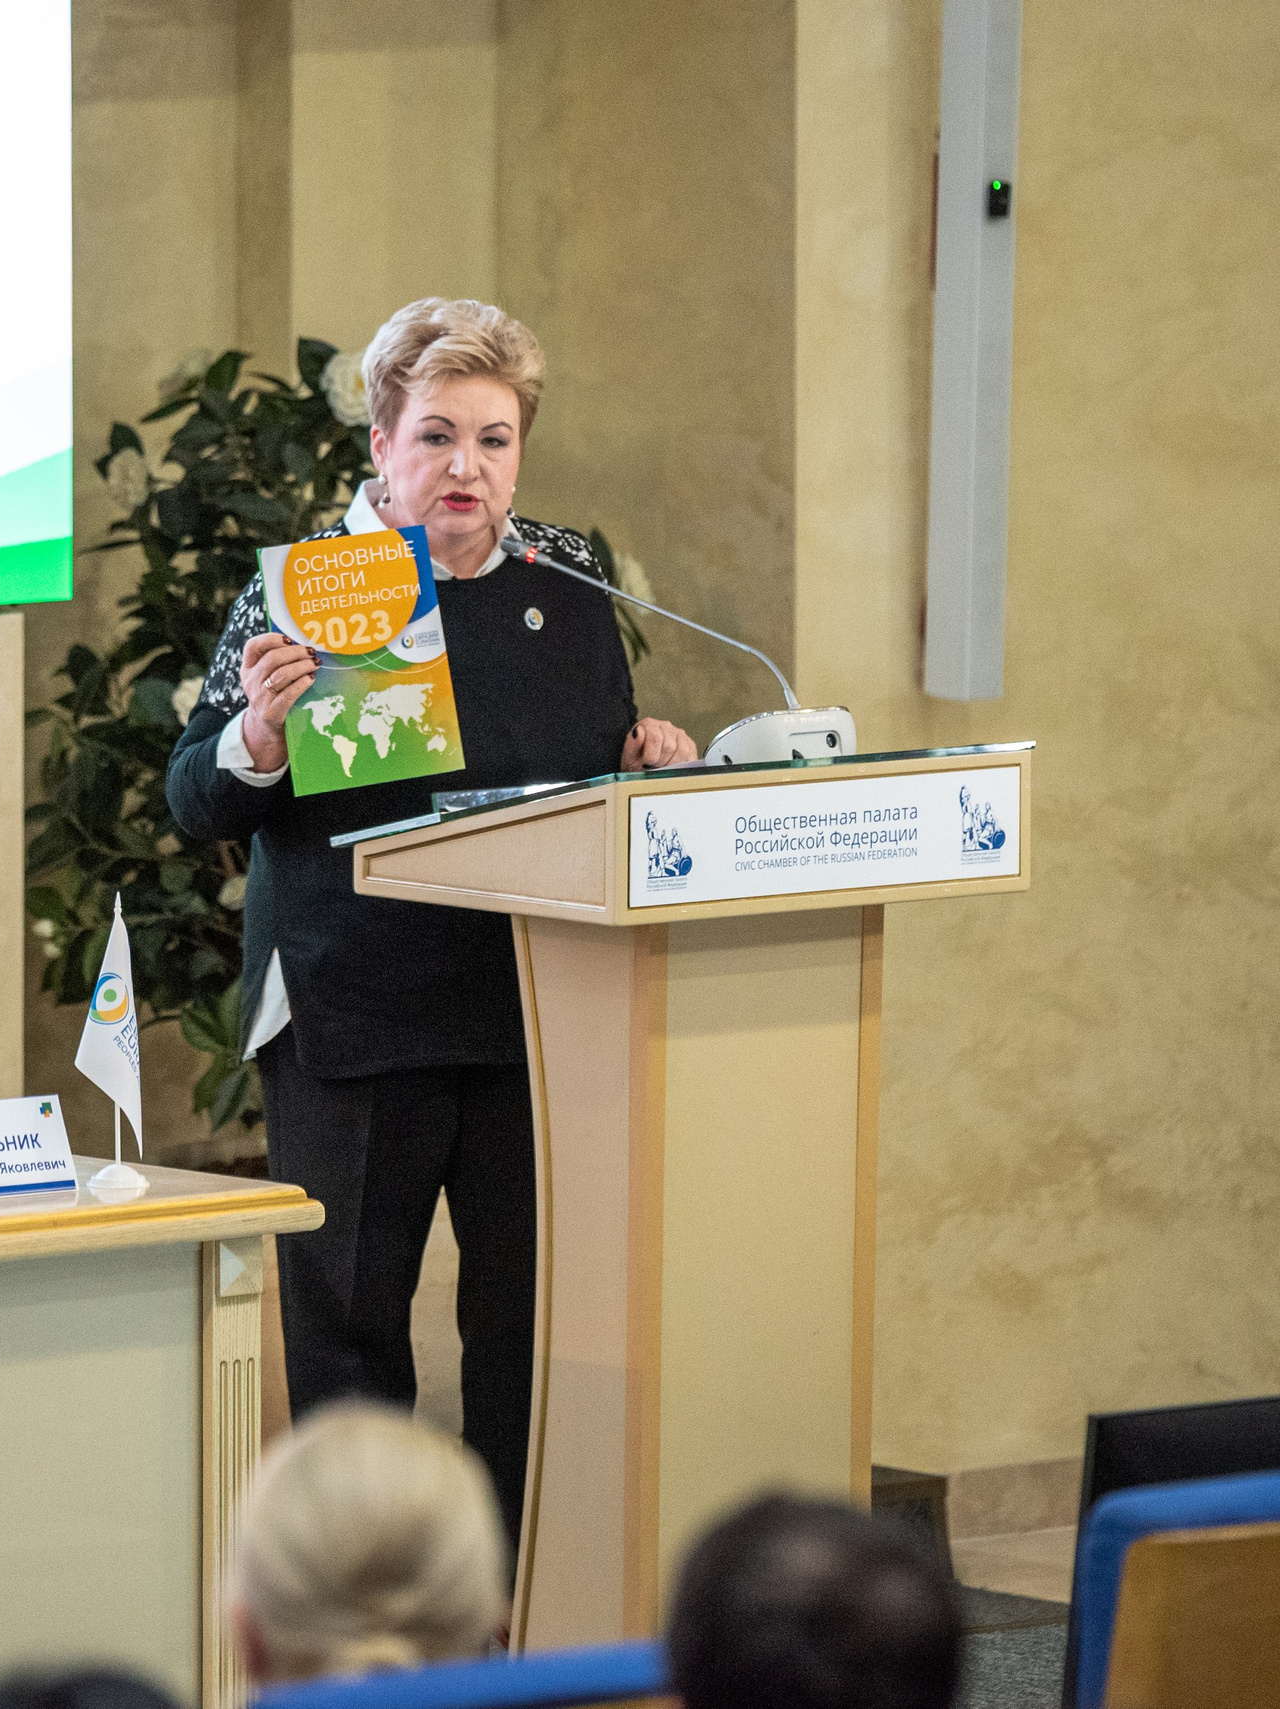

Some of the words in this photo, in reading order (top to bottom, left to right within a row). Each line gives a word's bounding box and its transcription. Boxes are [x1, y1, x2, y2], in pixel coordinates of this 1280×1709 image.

[294, 540, 417, 575] ОСНОВНЫЕ
[297, 570, 366, 597] ИТОГИ
[300, 583, 422, 617] ДЕЯТЕЛЬНОСТИ
[303, 610, 393, 649] 2023
[734, 811, 858, 835] Общественная
[863, 806, 919, 824] палата
[734, 831, 826, 856] Российской
[829, 828, 919, 850] Федерации
[734, 860, 756, 872] CIVIC
[757, 857, 799, 870] CHAMBER
[799, 855, 812, 867] OF
[813, 854, 830, 865] THE
[831, 851, 866, 864] RUSSIAN
[867, 847, 919, 861] FEDERATION
[0, 1159, 67, 1175] Яковлевич
